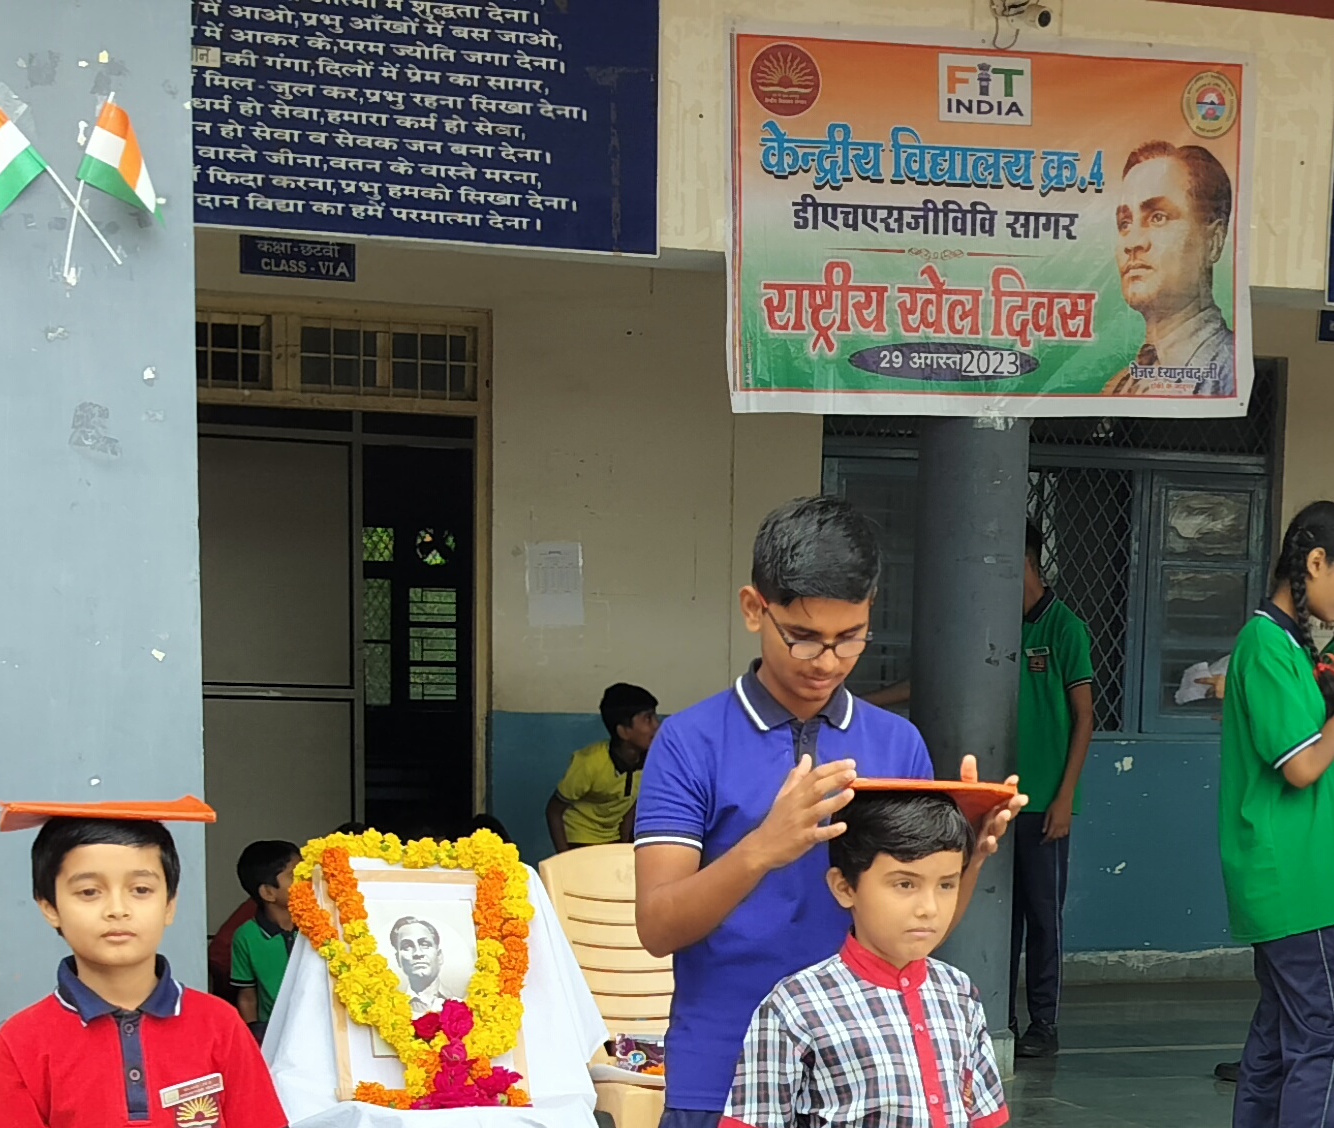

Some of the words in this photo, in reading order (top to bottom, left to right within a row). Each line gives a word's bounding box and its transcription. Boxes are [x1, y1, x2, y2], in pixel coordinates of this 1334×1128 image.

[204, 21, 224, 40] में
[230, 29, 300, 48] आकर
[389, 41, 456, 62] ज्योति
[461, 50, 511, 66] जगा
[349, 14, 419, 35] आँखों
[423, 20, 445, 37] में
[449, 26, 491, 41] बस
[223, 49, 259, 67] की
[378, 62, 400, 80] में
[404, 64, 441, 84] प्रेम
[446, 73, 481, 87] का
[192, 95, 232, 112] धर्म
[237, 97, 264, 117] हो
[393, 113, 437, 130] कर्म
[442, 114, 469, 134] हो
[409, 93, 465, 109] रहना
[469, 94, 533, 115] सिखा
[947, 98, 1024, 117] INDIA
[217, 119, 245, 139] हो
[249, 122, 302, 142] सेवा
[305, 132, 329, 145] व
[332, 129, 399, 150] सेवक
[402, 139, 443, 154] जन
[447, 143, 495, 158] बना
[760, 121, 884, 188] केन्द्रीय
[891, 127, 1035, 187] विद्यालय
[195, 144, 258, 162] वास्ते
[387, 157, 415, 174] के
[418, 162, 477, 180] वास्ते
[206, 166, 266, 188] फिदा
[385, 183, 453, 201] हमको
[457, 186, 523, 206] सिखा
[245, 193, 306, 213] विद्या
[310, 202, 346, 215] का
[349, 200, 386, 219] हमें
[390, 208, 483, 226] परमात्मा
[1006, 210, 1078, 240] सागर
[261, 258, 307, 274] CLASS
[763, 261, 888, 353] राष्ट्रीय
[898, 265, 982, 336] खेल
[992, 267, 1095, 348] दिवस
[880, 351, 903, 368] 29
[909, 353, 961, 370] अगस्त
[961, 353, 1020, 375] 2023
[1130, 362, 1155, 379] मेजर
